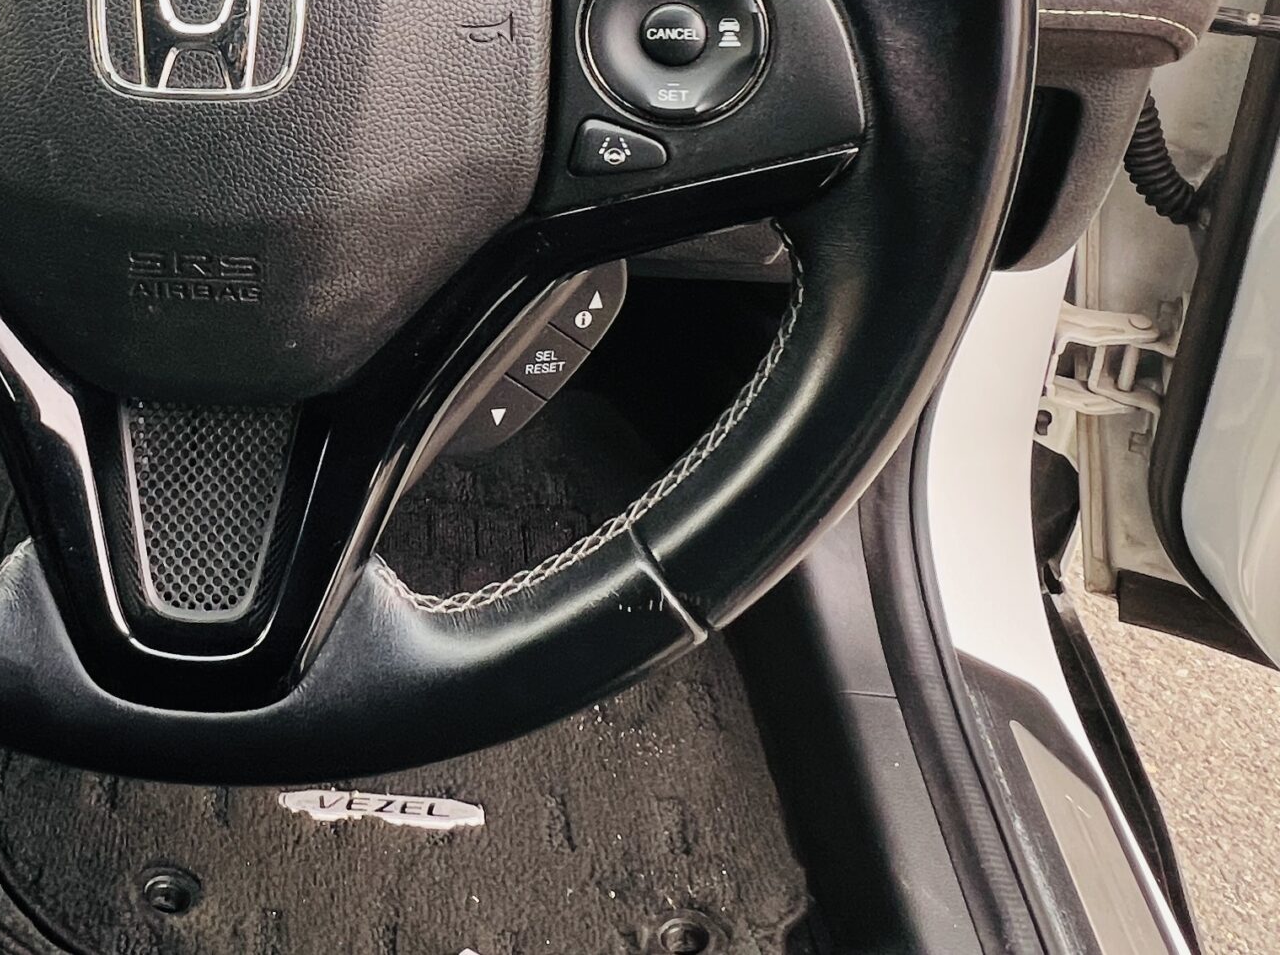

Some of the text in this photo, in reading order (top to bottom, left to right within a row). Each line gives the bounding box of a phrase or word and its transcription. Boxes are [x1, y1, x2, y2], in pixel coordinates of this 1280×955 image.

[646, 28, 700, 41] CANCEL
[657, 89, 689, 102] SET
[129, 251, 261, 277] SRS
[129, 282, 261, 302] AIRBAG
[535, 350, 558, 362] SEL
[525, 361, 566, 375] RESET
[318, 794, 451, 818] VEZEL
